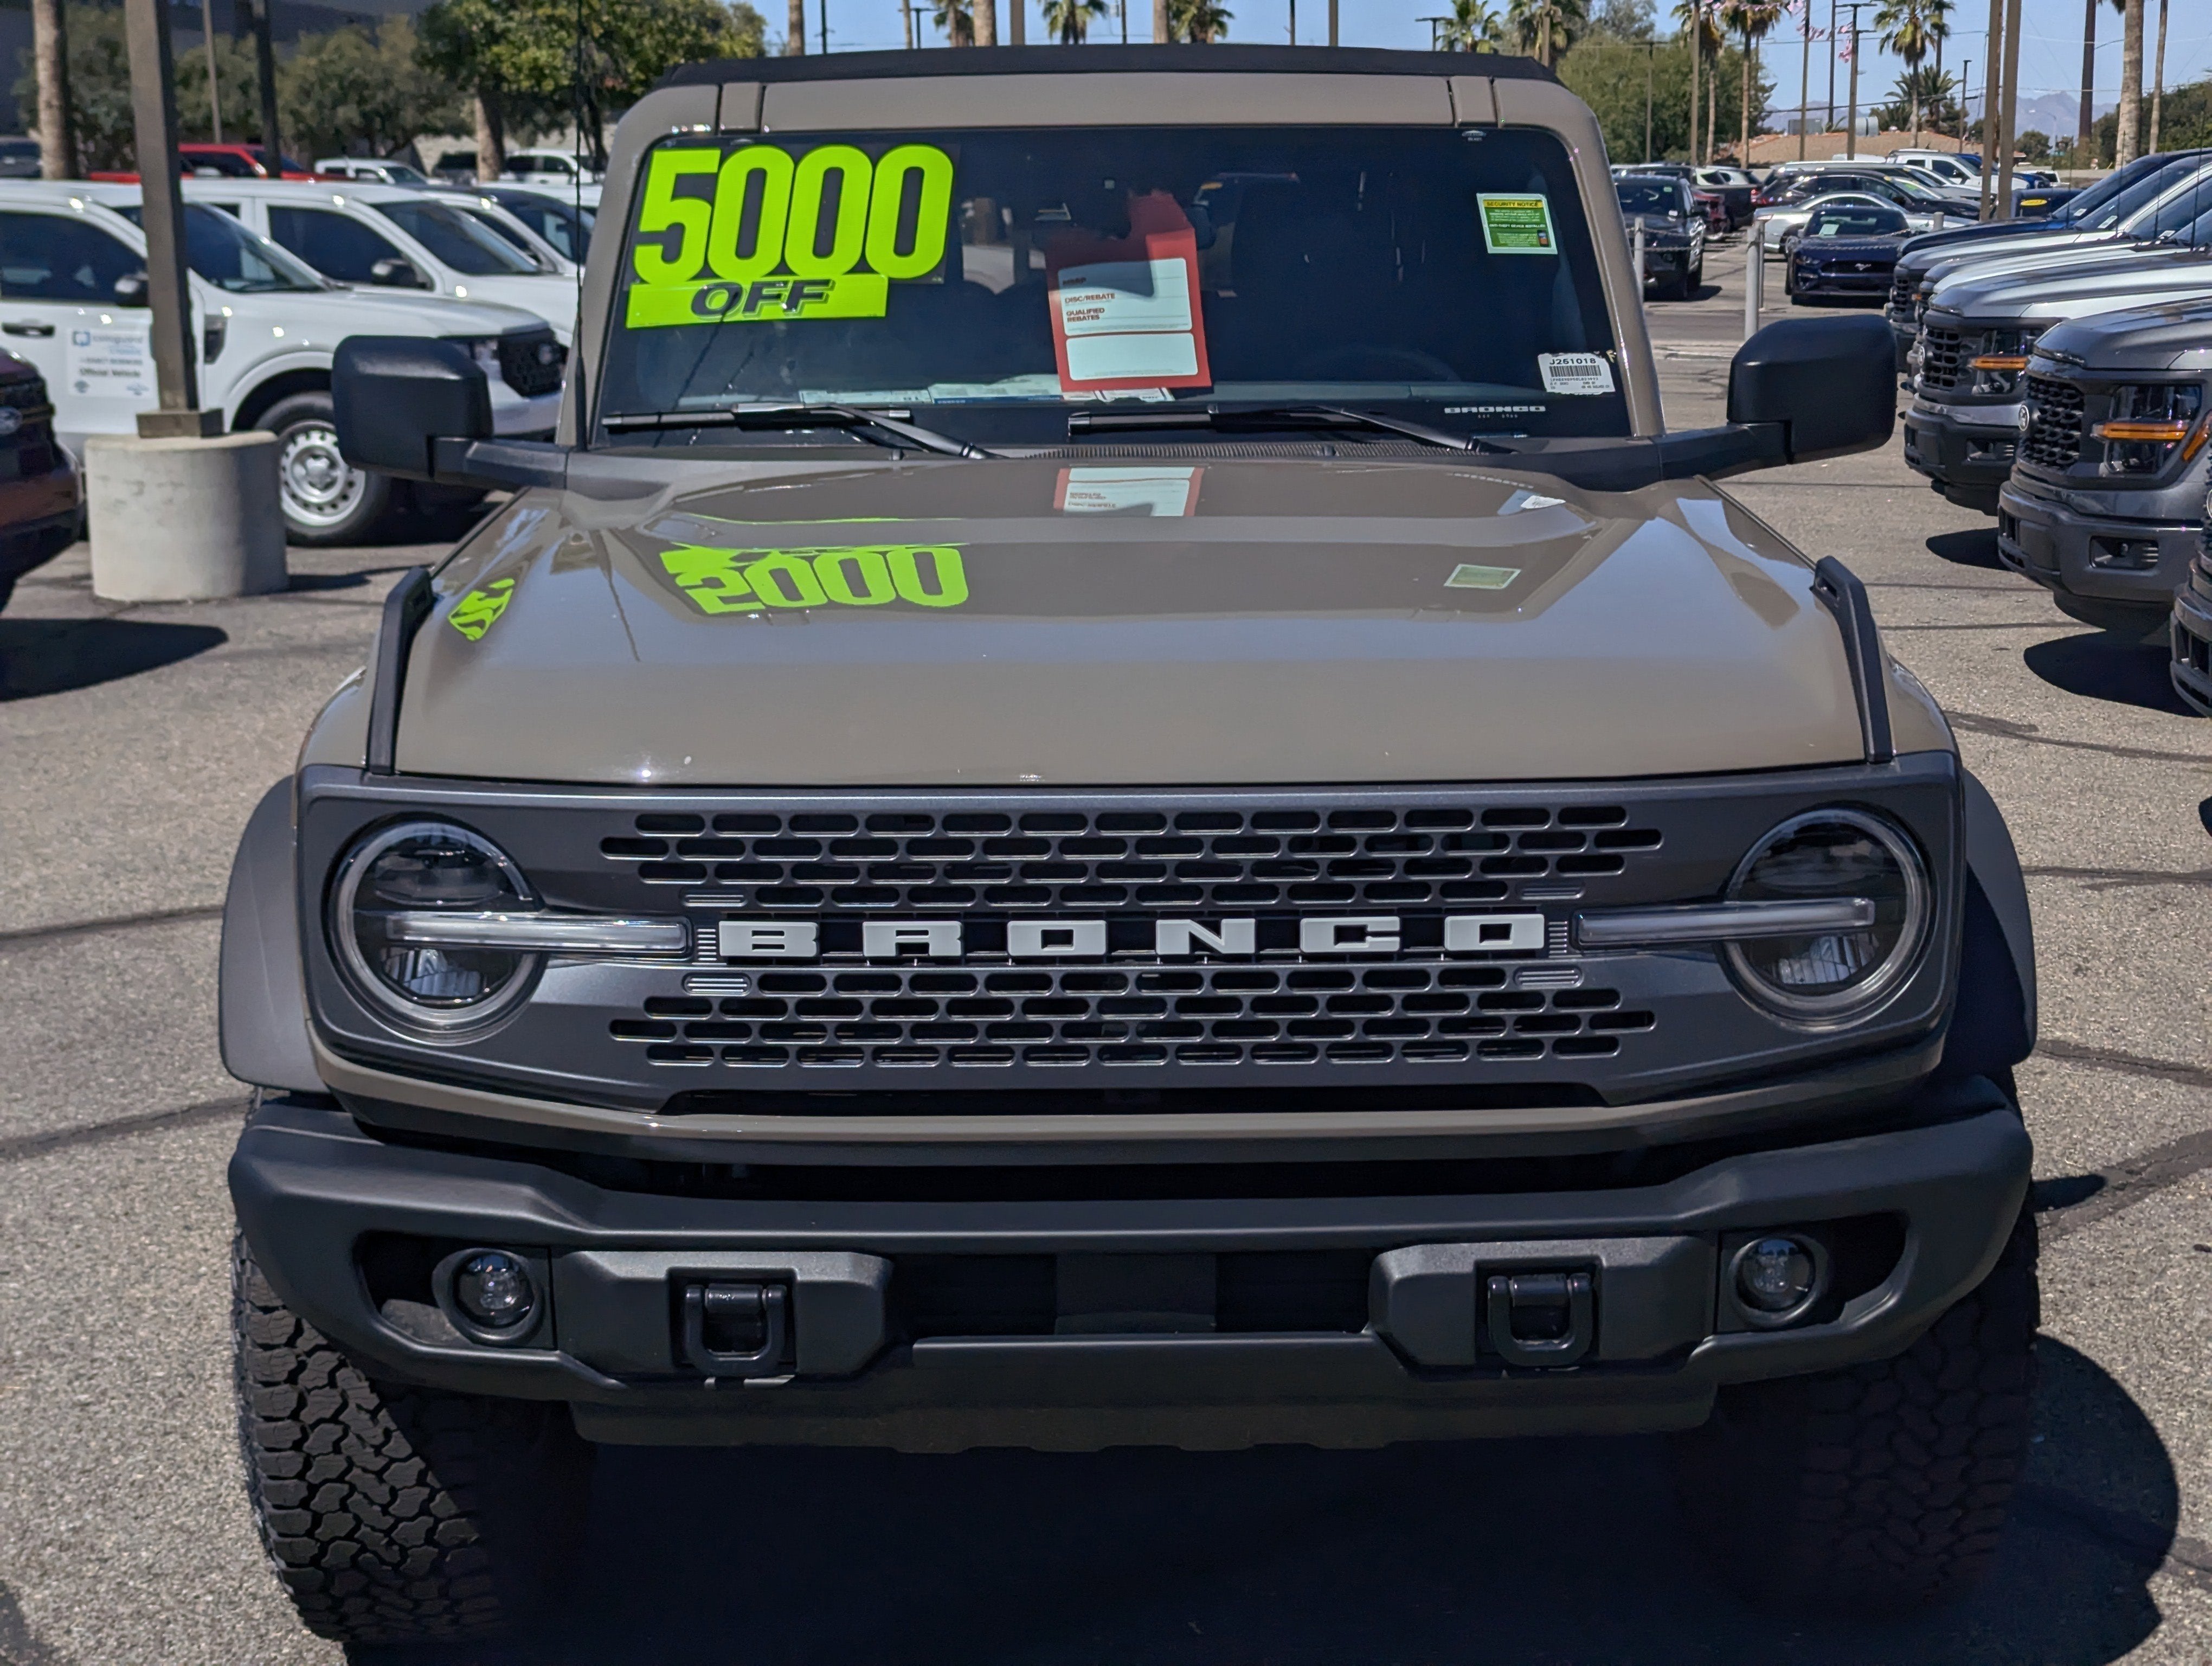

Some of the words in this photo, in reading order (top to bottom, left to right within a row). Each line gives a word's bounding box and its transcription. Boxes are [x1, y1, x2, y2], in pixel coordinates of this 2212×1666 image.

[634, 145, 953, 284] 5000
[691, 278, 835, 321] OFF
[1065, 293, 1115, 304] DISC/REBATE
[1066, 307, 1105, 316] QUALIFIED
[1067, 315, 1100, 323] REBATES
[719, 913, 1545, 957] BRONCO
